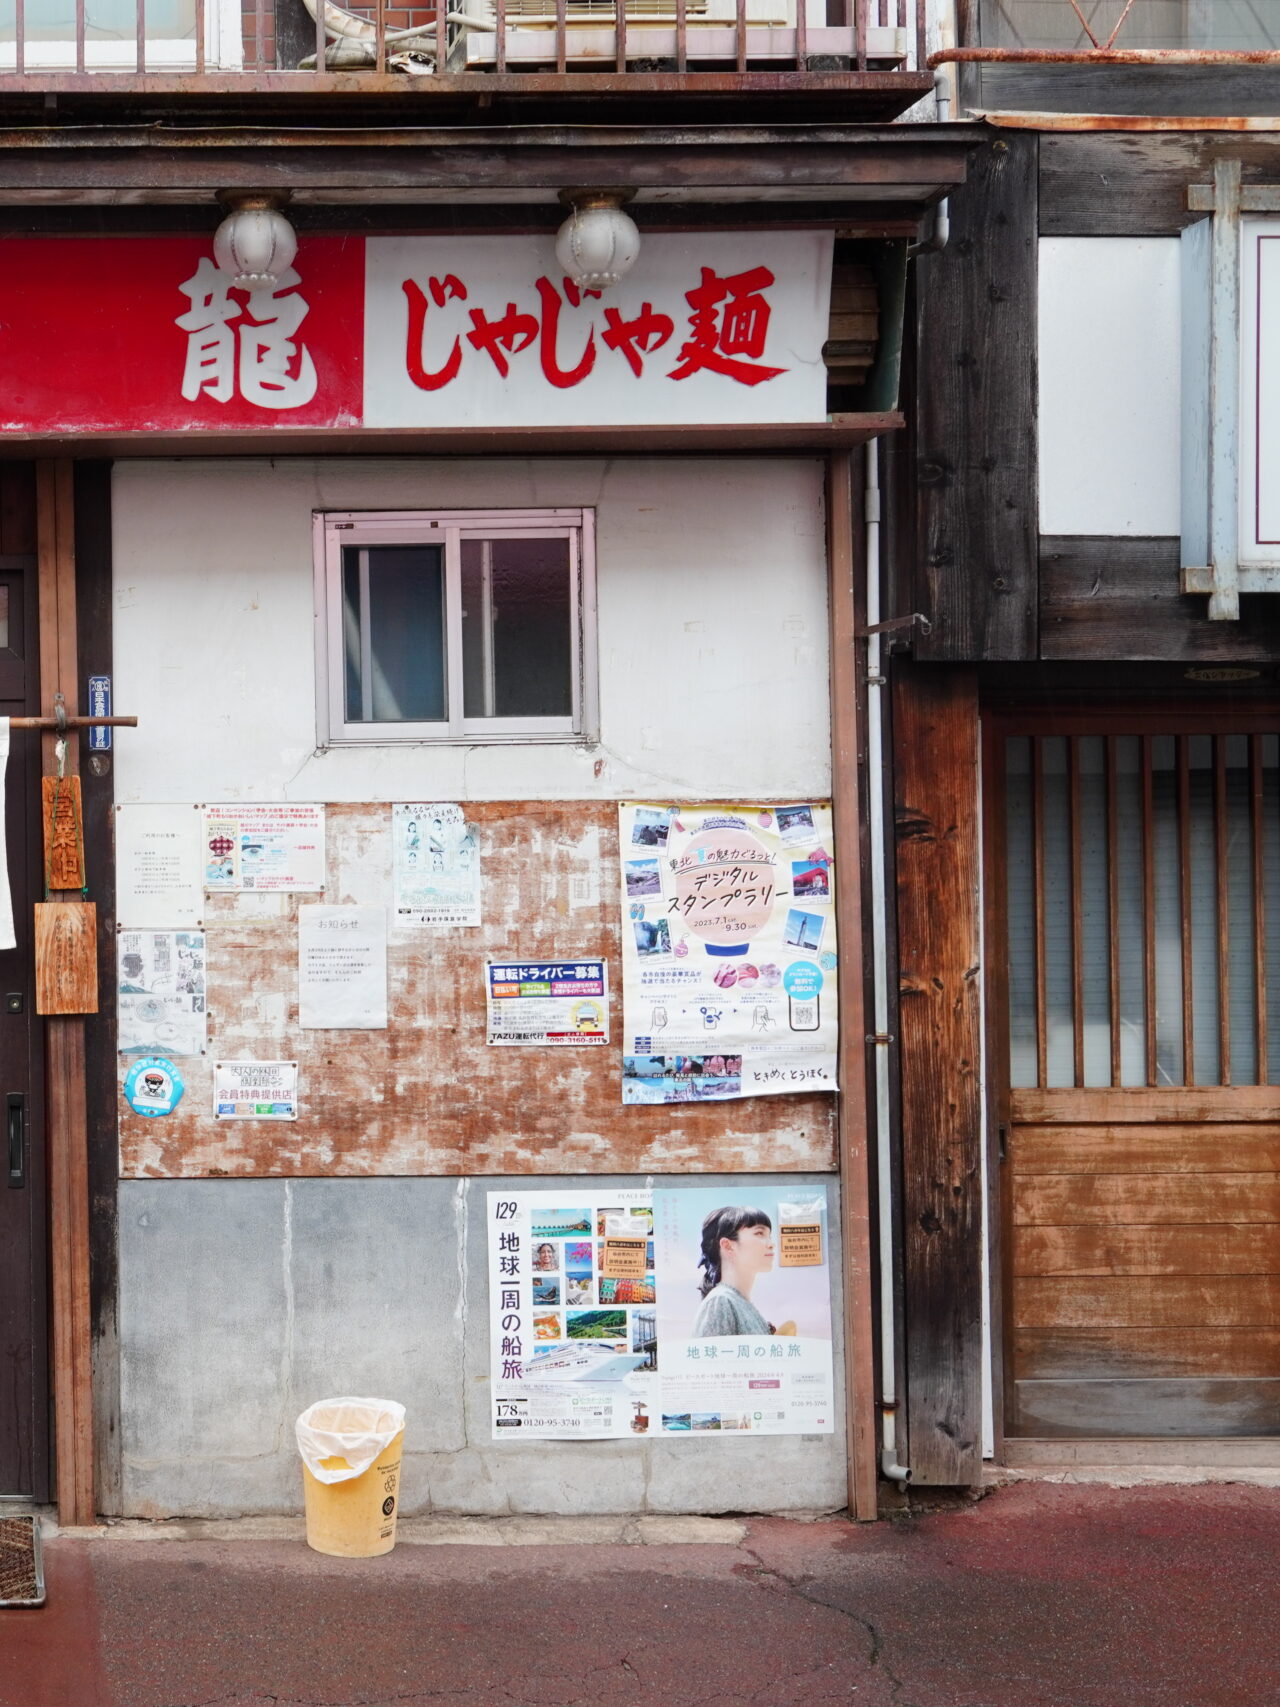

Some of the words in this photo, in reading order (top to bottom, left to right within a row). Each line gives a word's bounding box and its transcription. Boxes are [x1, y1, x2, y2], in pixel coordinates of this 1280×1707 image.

[402, 265, 790, 391] じゃじゃ麺
[694, 866, 759, 892] デジタル
[668, 885, 789, 915] スタンプラリー
[319, 920, 359, 929] お知らせ
[493, 966, 600, 981] 運転ドライバー募集
[491, 1032, 544, 1040] TAZU運転代行
[218, 1089, 292, 1100] 会員特典提供店
[495, 1201, 518, 1219] 129
[499, 1232, 523, 1380] 地球一周の船旅
[686, 1343, 802, 1359] 地球一周の船旅
[496, 1404, 518, 1417] 178
